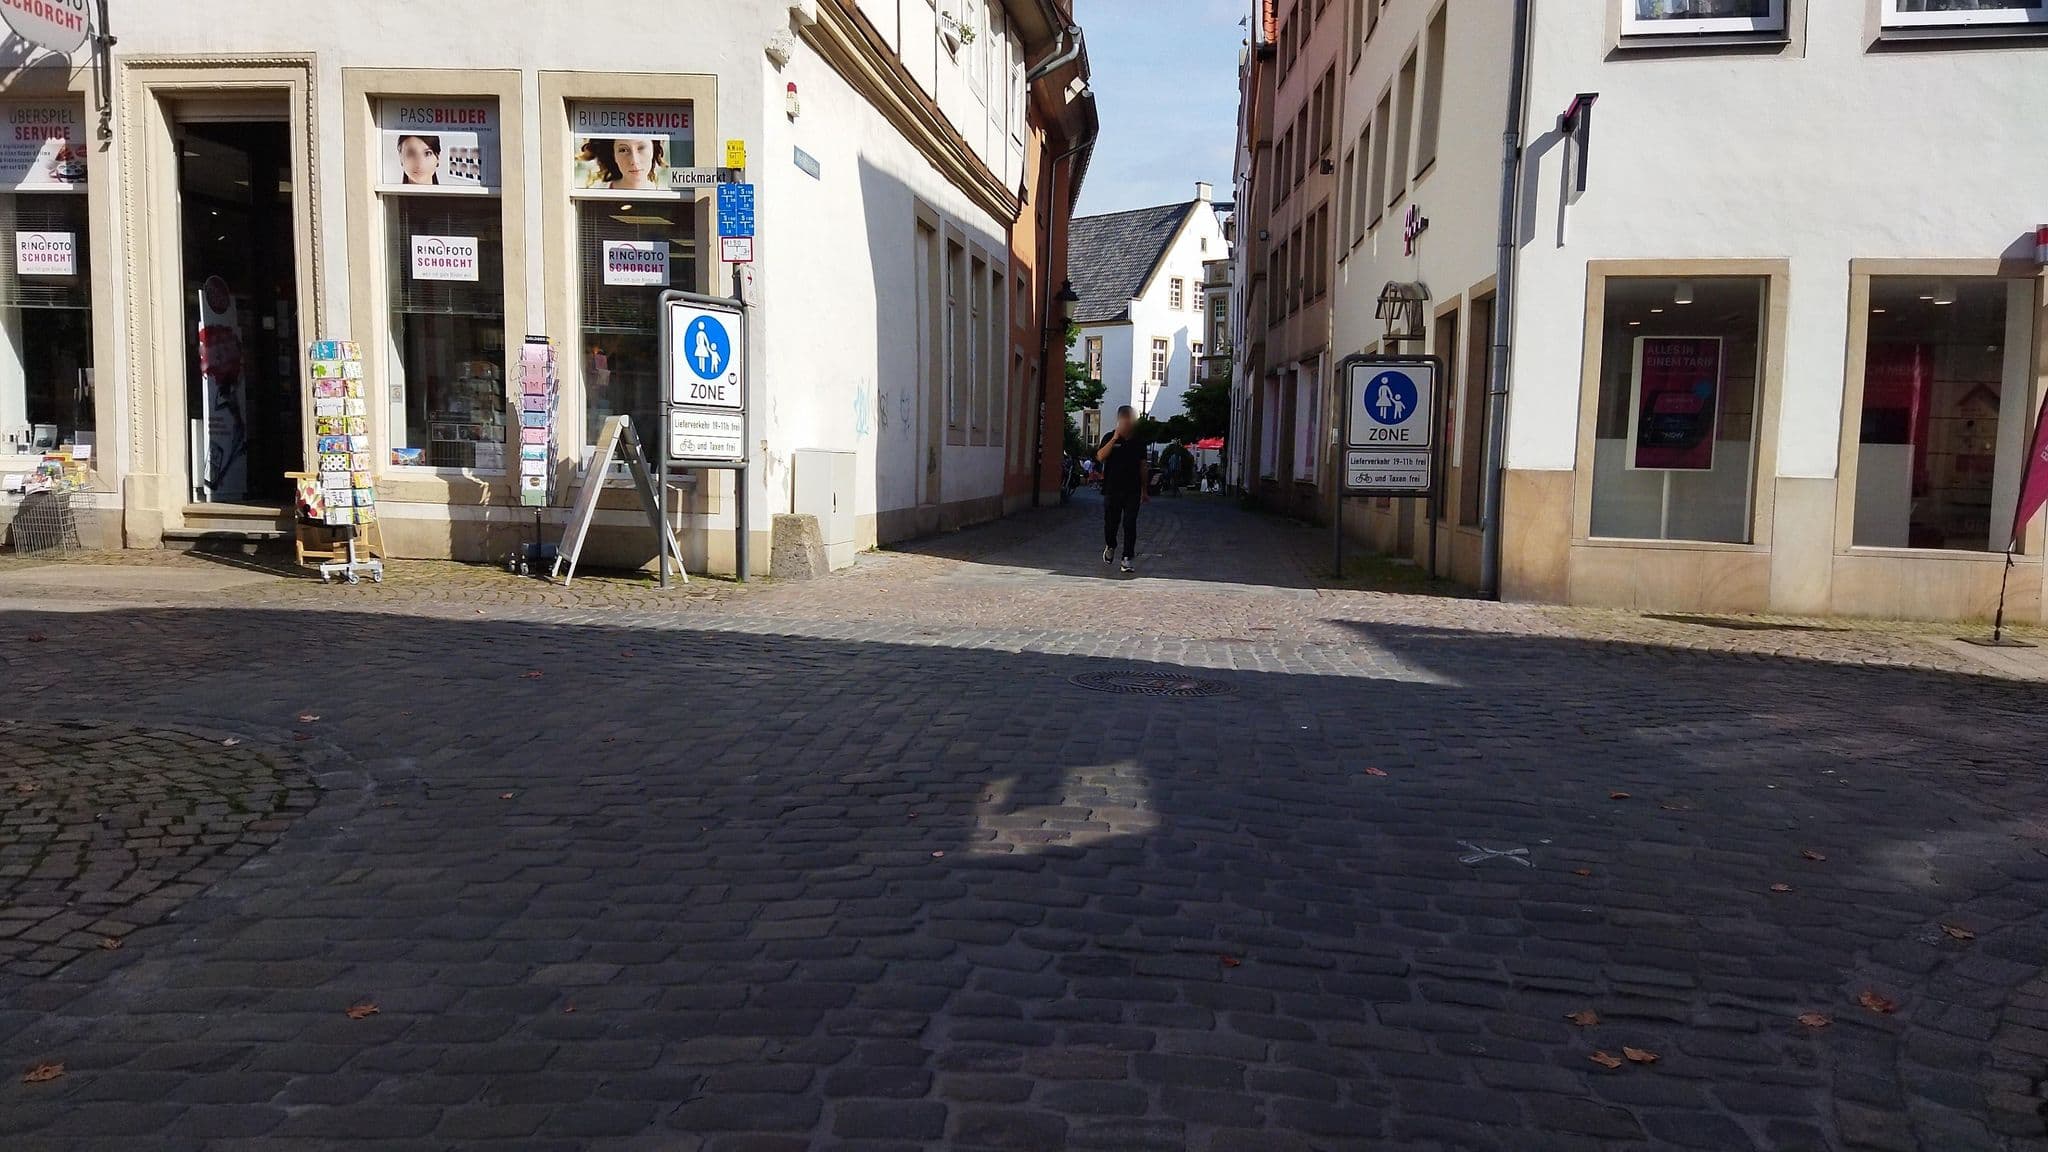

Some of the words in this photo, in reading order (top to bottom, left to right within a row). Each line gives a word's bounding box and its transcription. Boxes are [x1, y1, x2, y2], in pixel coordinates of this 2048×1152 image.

[1, 0, 83, 32] CHORCHT
[400, 107, 487, 125] PASSBILDER
[579, 110, 689, 129] BILDERSERVICE
[15, 126, 71, 140] SERVICE
[671, 170, 726, 184] Krickmarkt
[21, 252, 72, 263] SCHORCHT
[417, 257, 473, 269] SCHORCHT
[609, 262, 665, 273] SCHORCHT
[690, 383, 726, 401] ZONE
[1368, 428, 1410, 441] ZONE
[1350, 456, 1390, 465] Lieferverkehr
[1415, 457, 1427, 466] frei
[1374, 474, 1387, 483] und
[1409, 474, 1421, 484] frei
